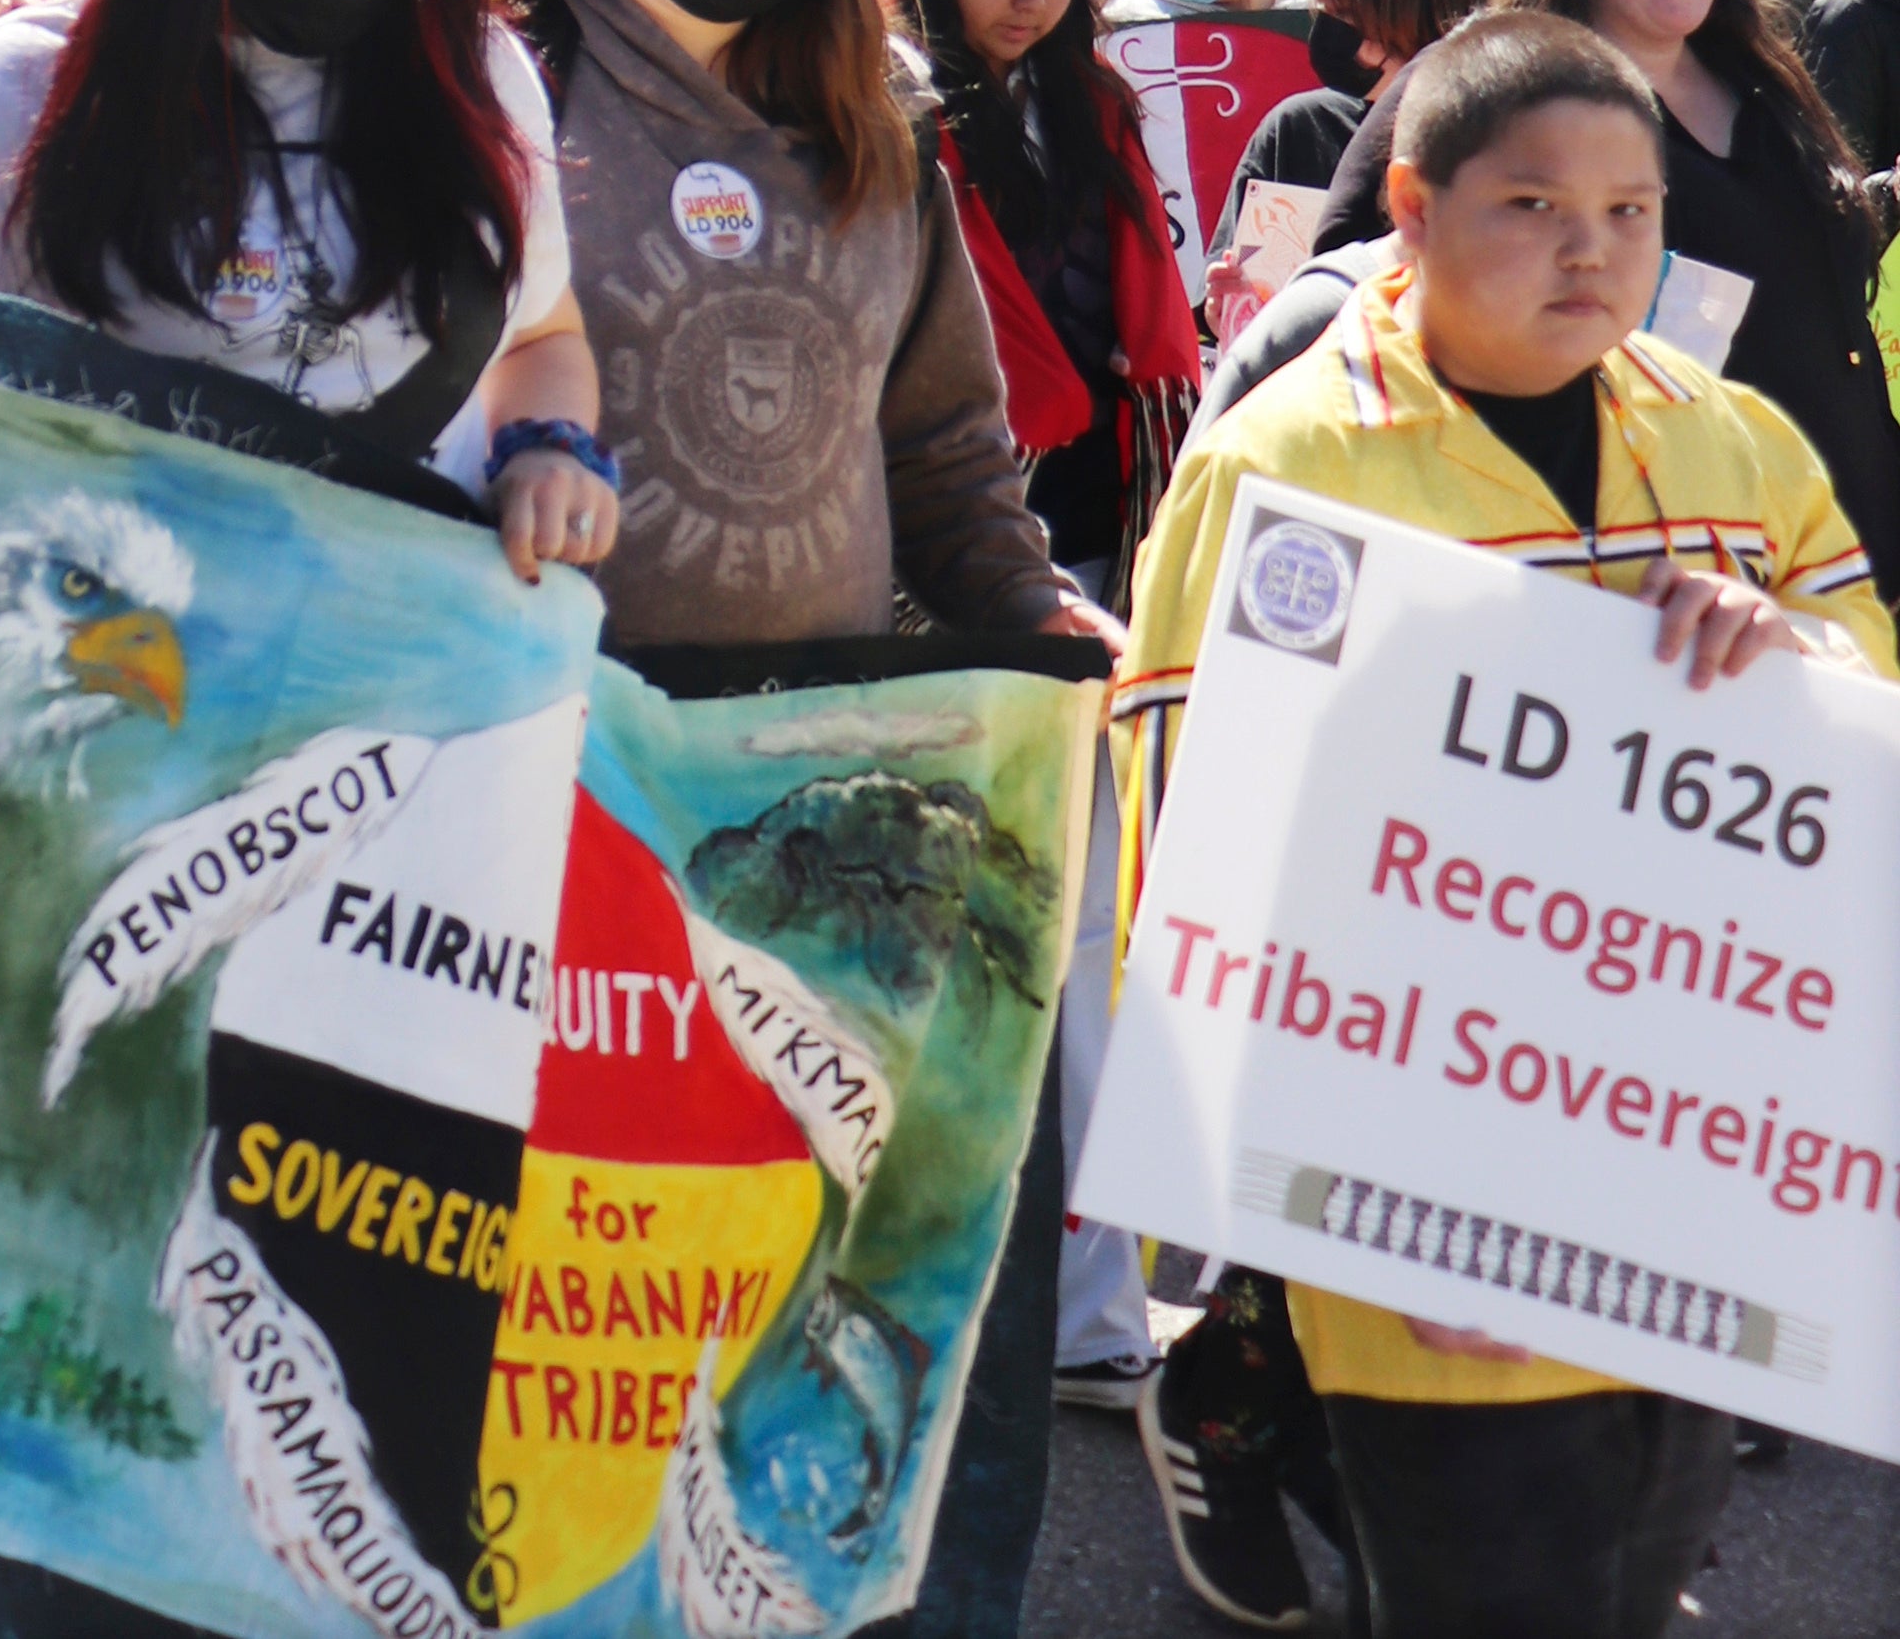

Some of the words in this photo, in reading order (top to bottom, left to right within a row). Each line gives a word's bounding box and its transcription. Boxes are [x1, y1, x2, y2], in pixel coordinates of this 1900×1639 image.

[681, 192, 749, 219] SUPPORT
[685, 217, 711, 234] LD
[715, 213, 753, 231] 906
[84, 740, 398, 987] PENOBSCOT
[1443, 673, 1570, 782] LD
[1611, 730, 1832, 870] 1626
[1370, 816, 1837, 1033] Recognize
[1164, 914, 1423, 1067] Tribal
[1443, 1006, 1900, 1220] Sovereign
[227, 1121, 512, 1294] SOVEREIG
[565, 1175, 658, 1244] for
